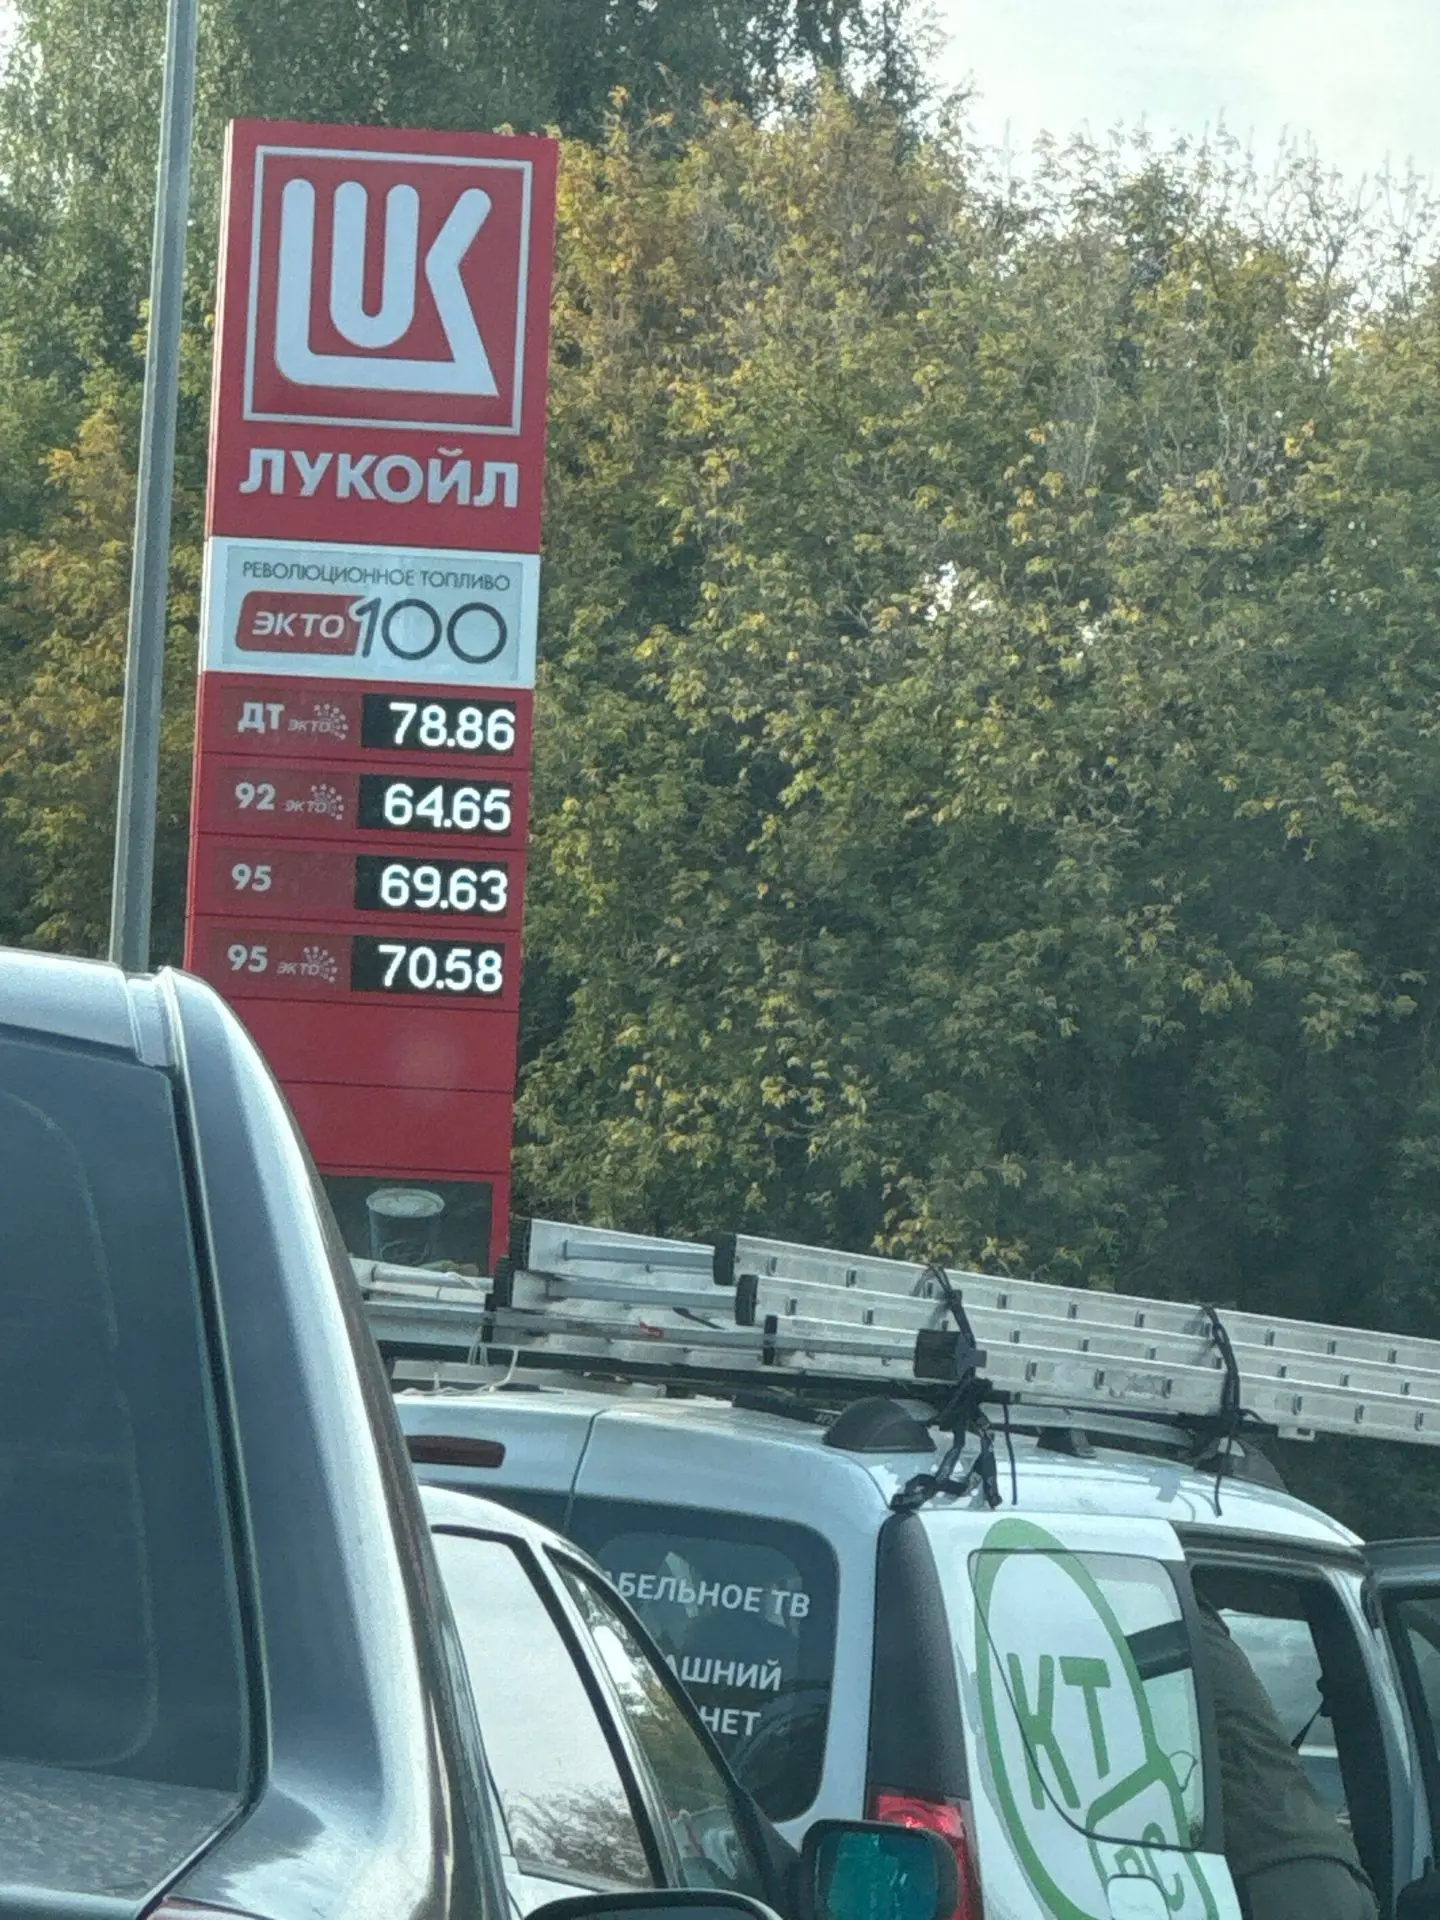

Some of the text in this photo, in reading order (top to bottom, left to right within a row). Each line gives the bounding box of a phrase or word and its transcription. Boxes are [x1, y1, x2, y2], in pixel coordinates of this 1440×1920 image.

[239, 447, 519, 509] ЛУКОЙЛ
[242, 561, 511, 592] РЕВОЛЮЦИОННОЕ ТОПЛИВО
[251, 597, 508, 665] ЭКТО 100
[237, 702, 285, 734] ДТ
[389, 702, 516, 751] 78.86
[235, 782, 276, 811] 92
[384, 783, 511, 831] 64.65
[231, 863, 509, 912] 95 69.63
[227, 944, 268, 973] 95
[378, 944, 503, 993] 70.58
[602, 1571, 810, 1618] БЕЛЬНОЕ ТВ
